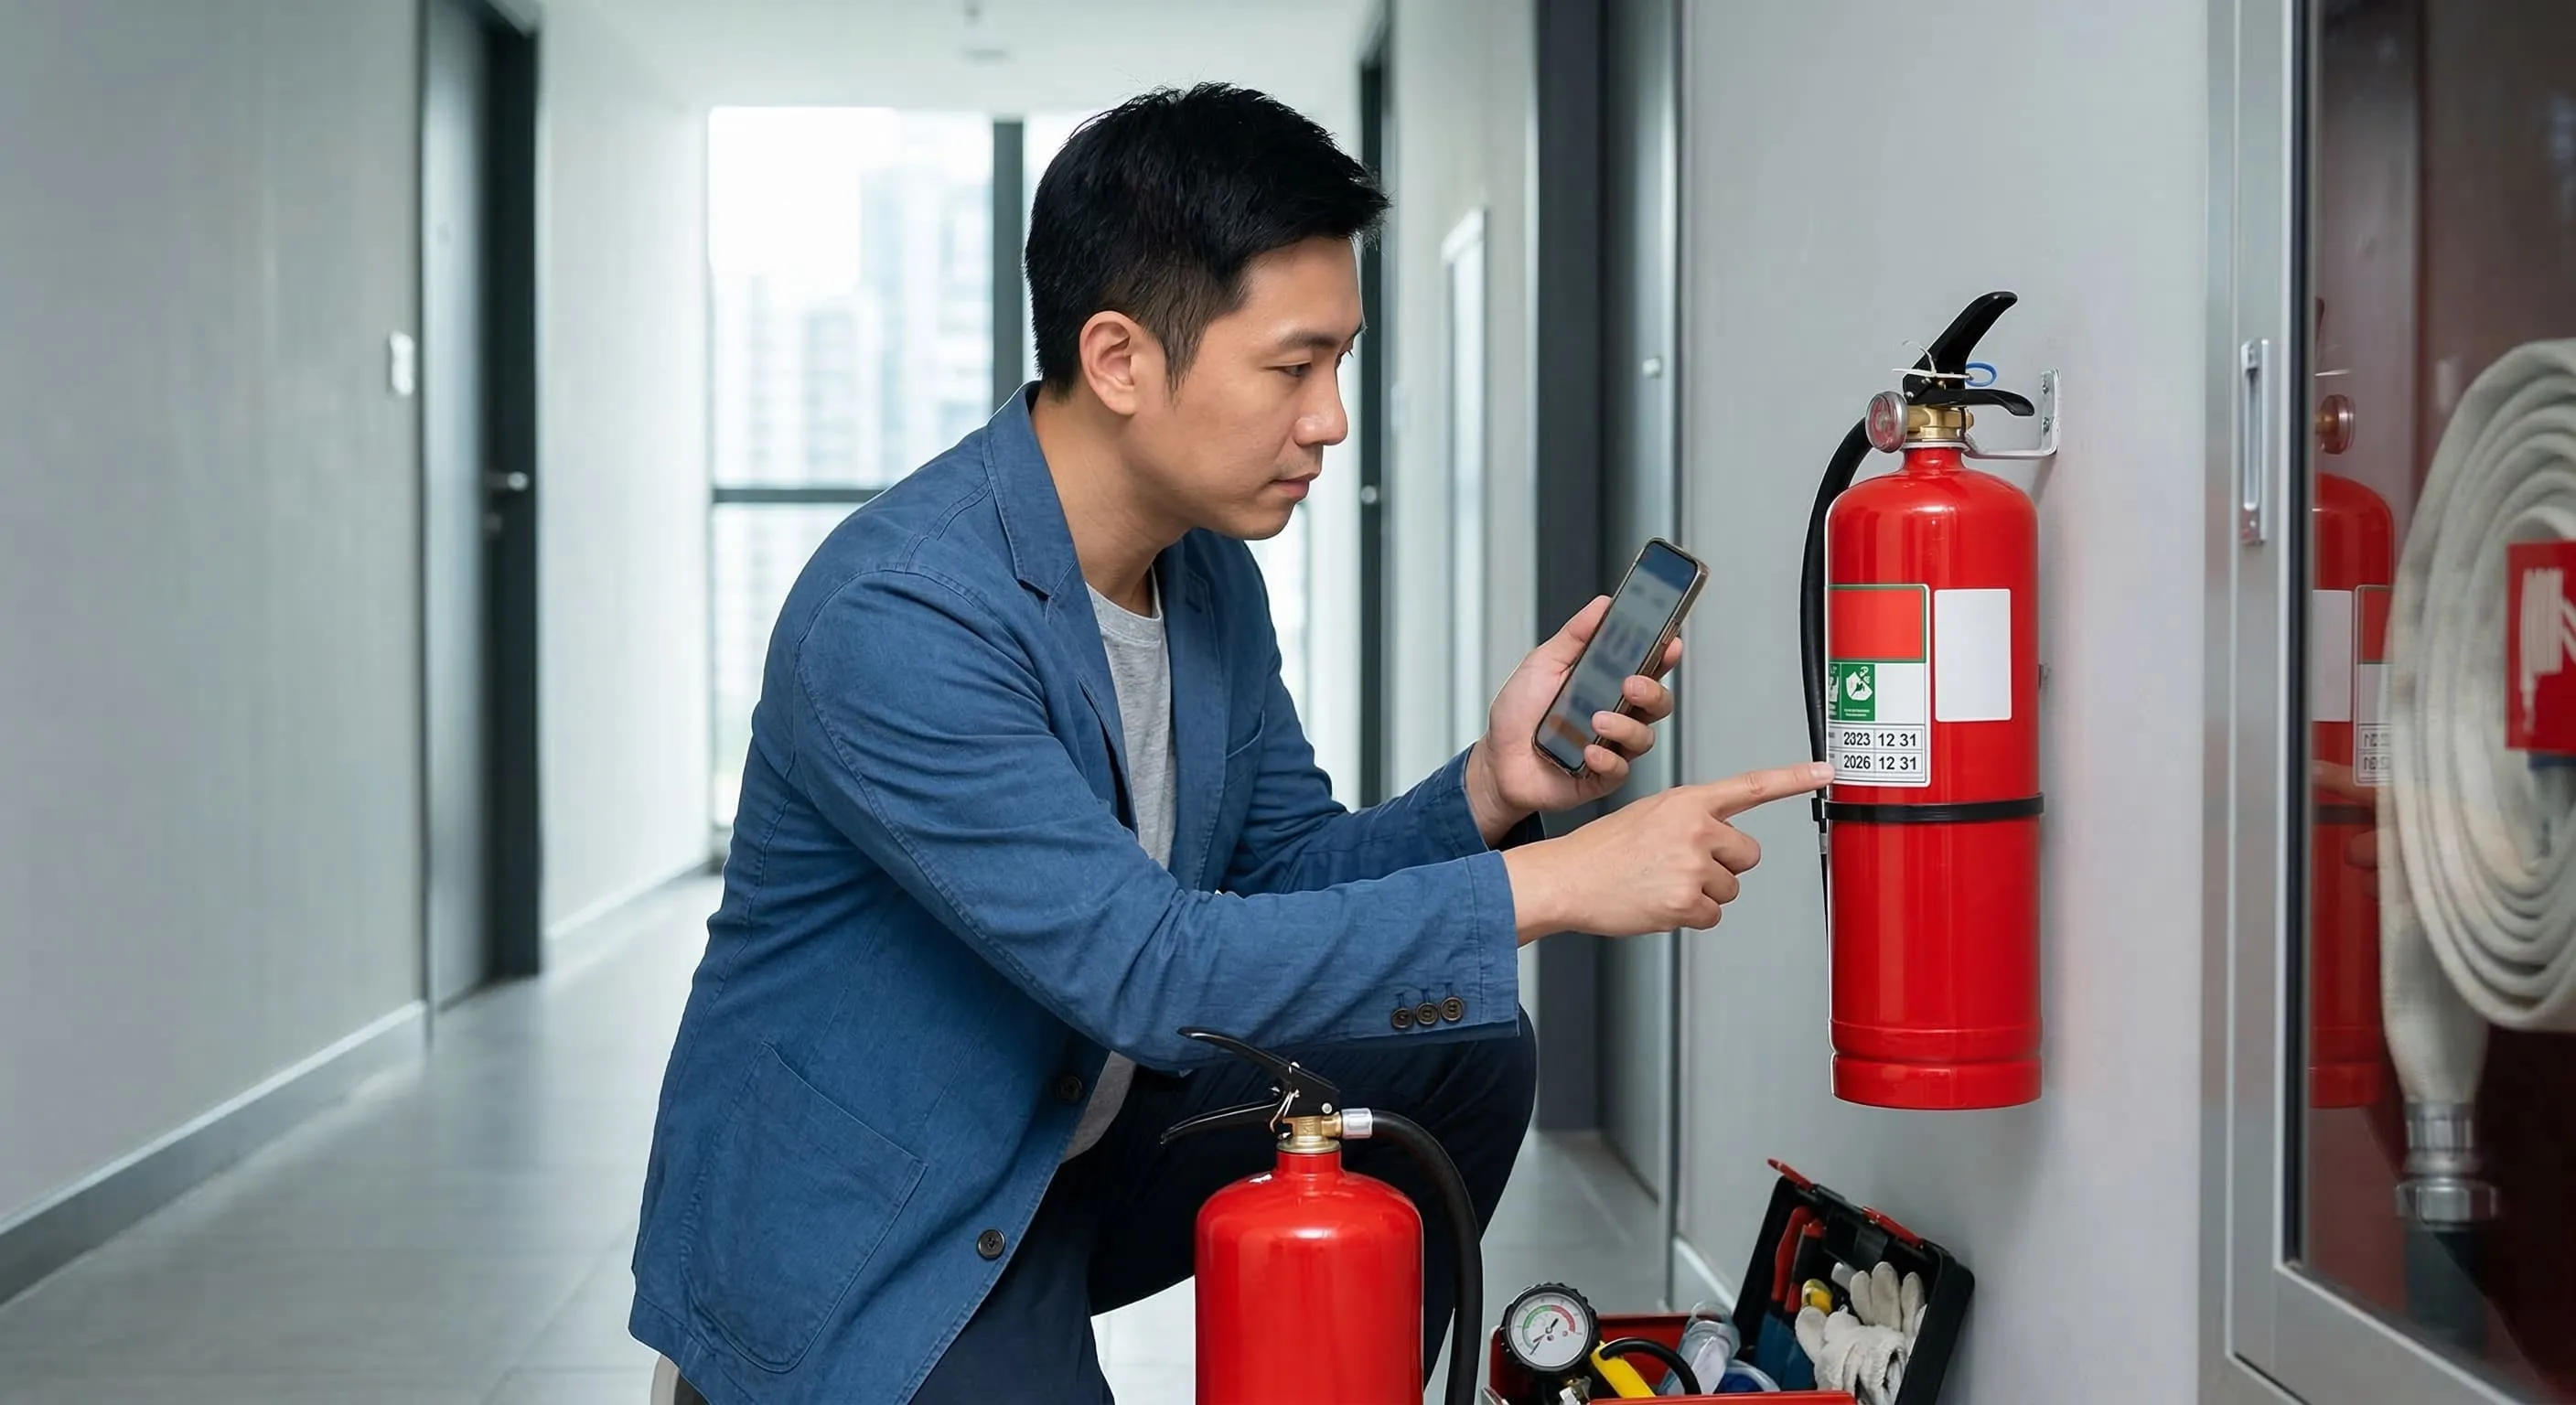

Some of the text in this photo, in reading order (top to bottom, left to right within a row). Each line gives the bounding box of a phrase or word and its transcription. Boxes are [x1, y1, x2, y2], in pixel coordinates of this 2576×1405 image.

[1843, 731, 1871, 746] 2323
[1877, 733, 1895, 747] 12
[1899, 733, 1916, 747] 31
[1843, 755, 1916, 770] 2026 12 31
